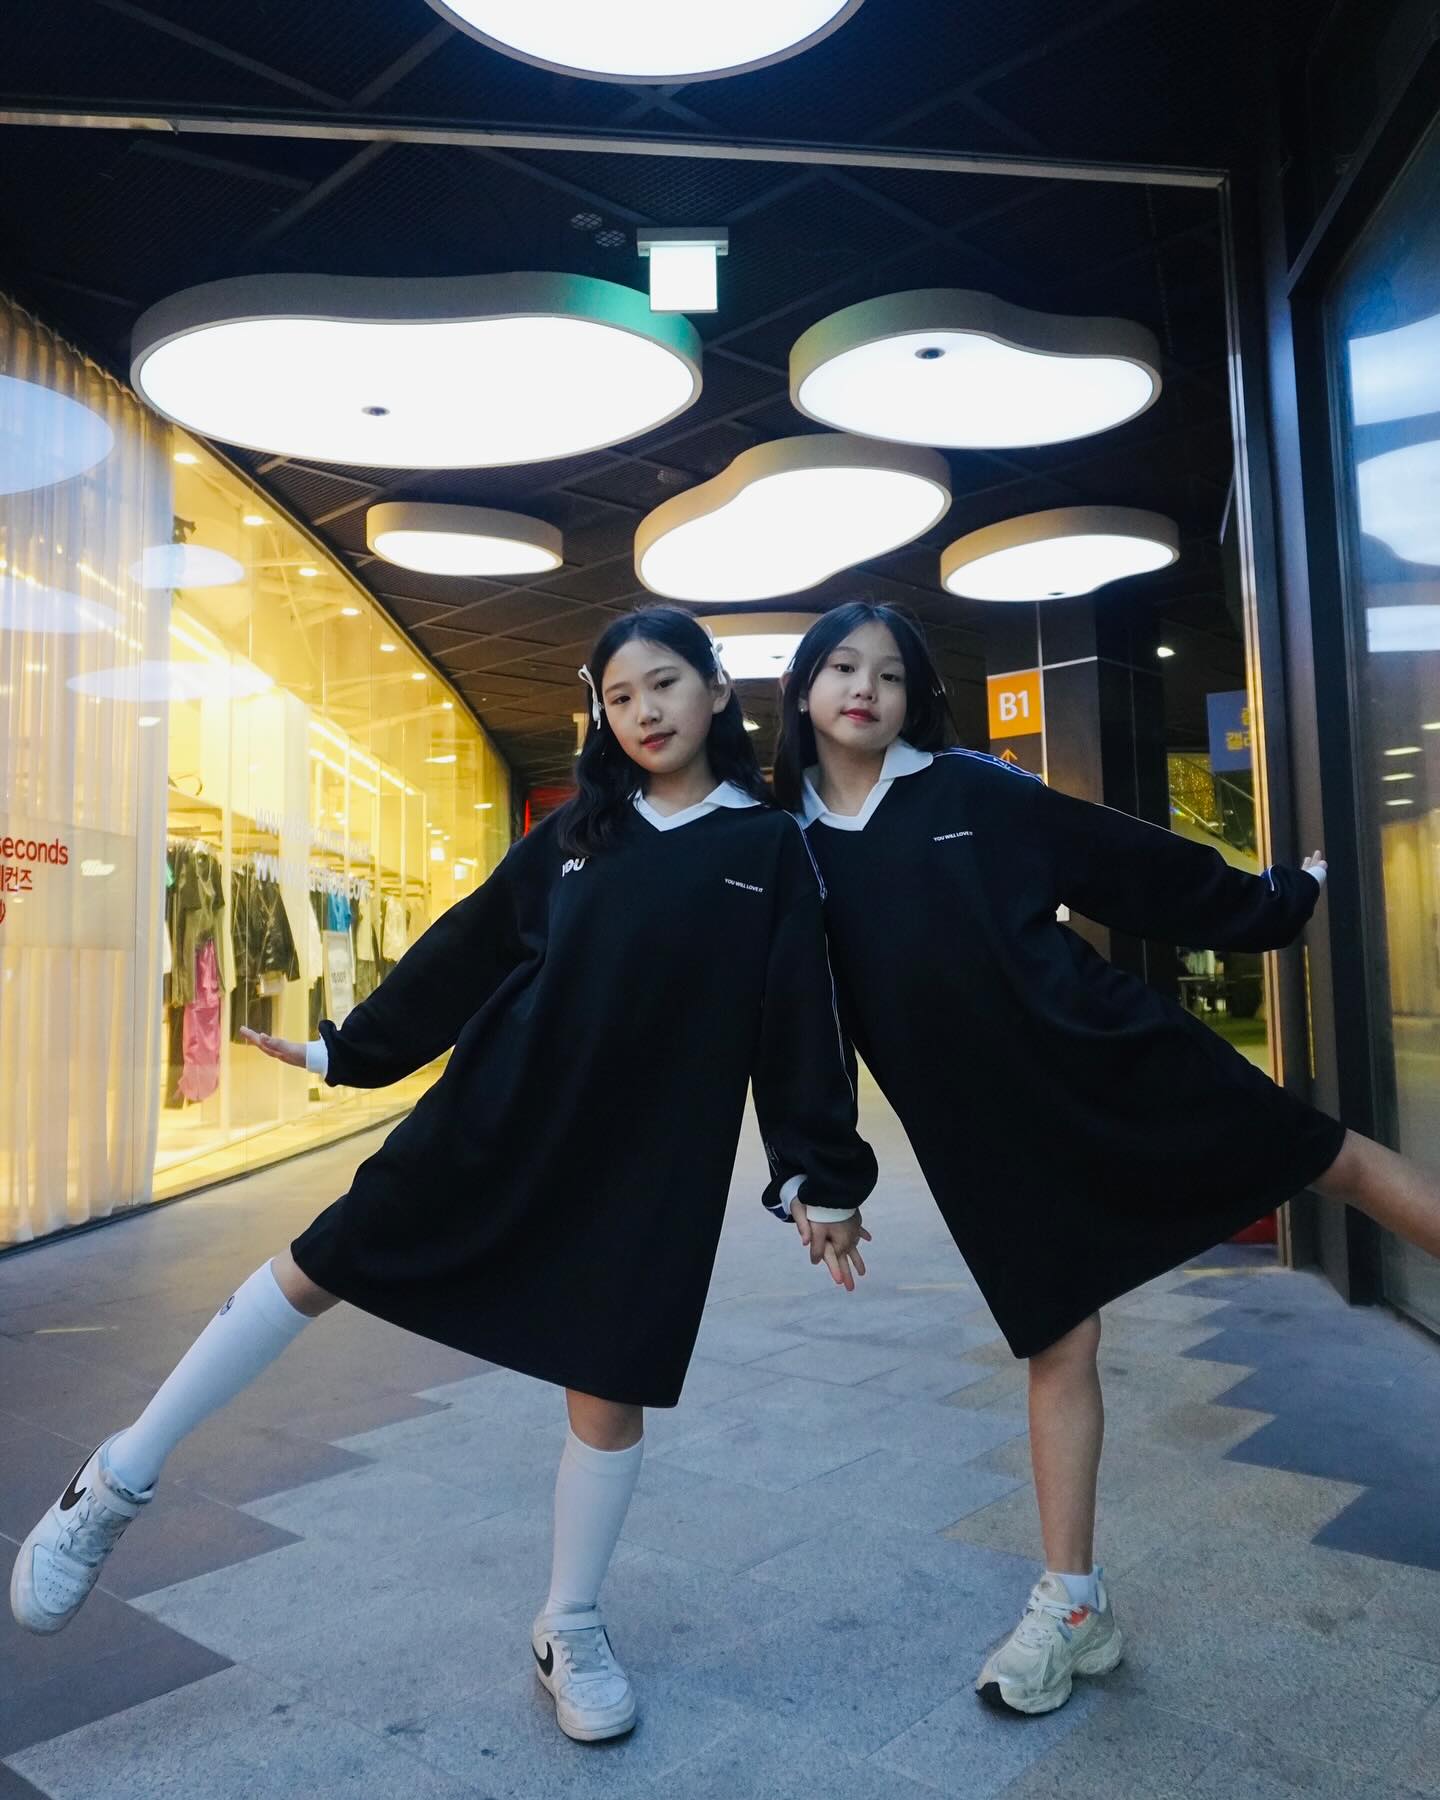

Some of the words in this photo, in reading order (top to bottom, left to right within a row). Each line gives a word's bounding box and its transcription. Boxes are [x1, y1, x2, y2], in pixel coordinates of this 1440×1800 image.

[999, 690, 1029, 721] B1
[0, 837, 69, 865] econds
[724, 878, 736, 886] YOU
